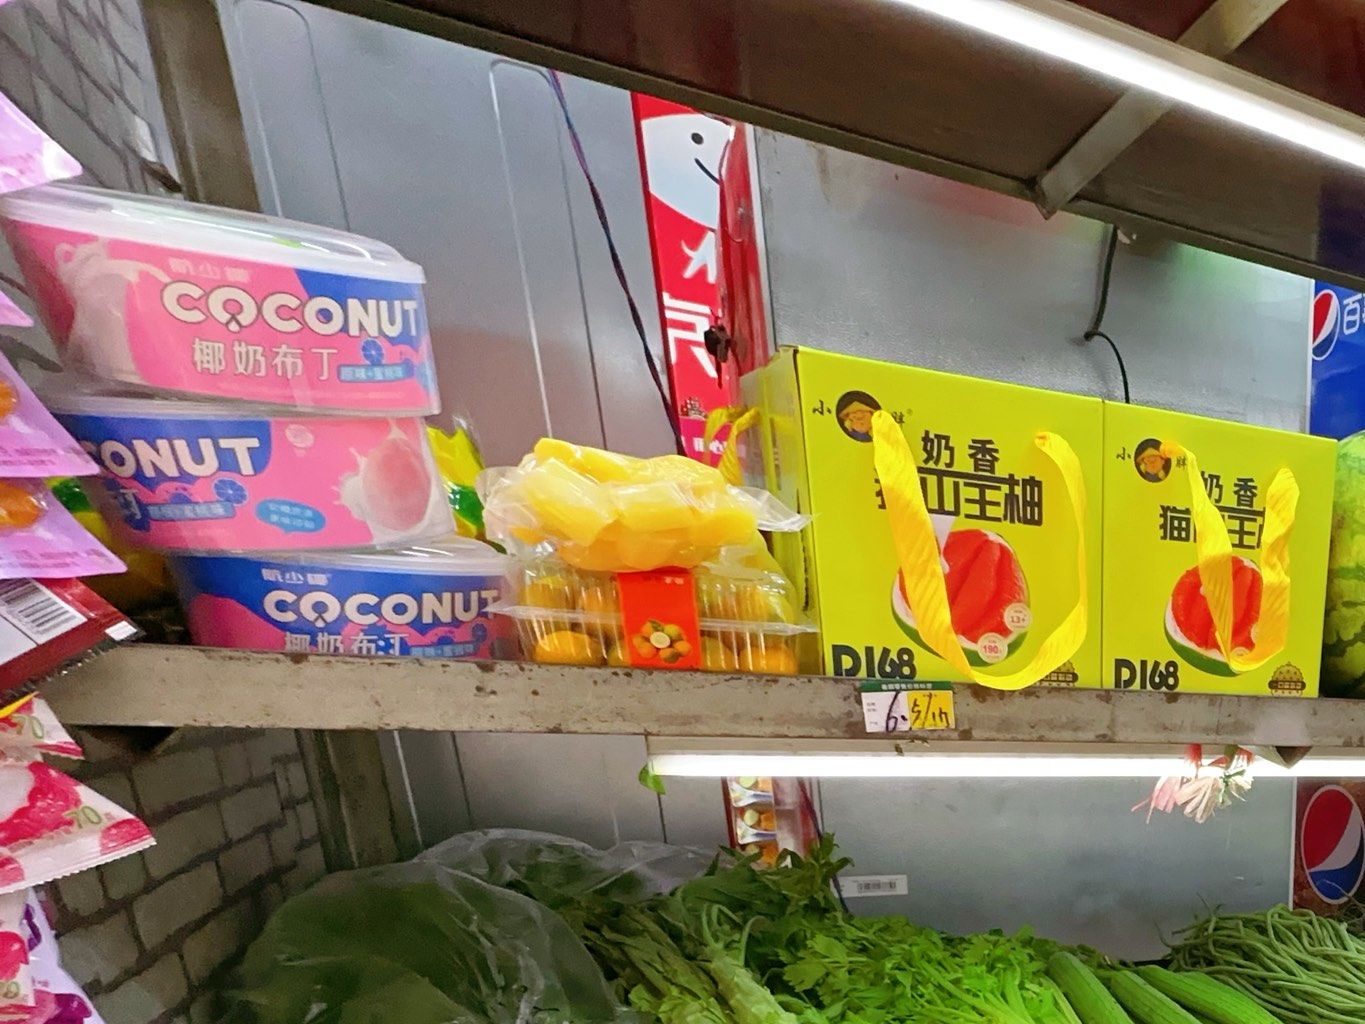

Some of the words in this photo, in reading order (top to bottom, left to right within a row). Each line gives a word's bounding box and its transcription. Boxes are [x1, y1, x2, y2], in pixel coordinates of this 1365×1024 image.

[160, 280, 418, 337] COCONUT
[193, 337, 338, 381] 椰奶布丁
[921, 430, 1000, 474] 奶香
[874, 466, 1043, 526] 山王柚
[263, 589, 500, 628] COCONUT
